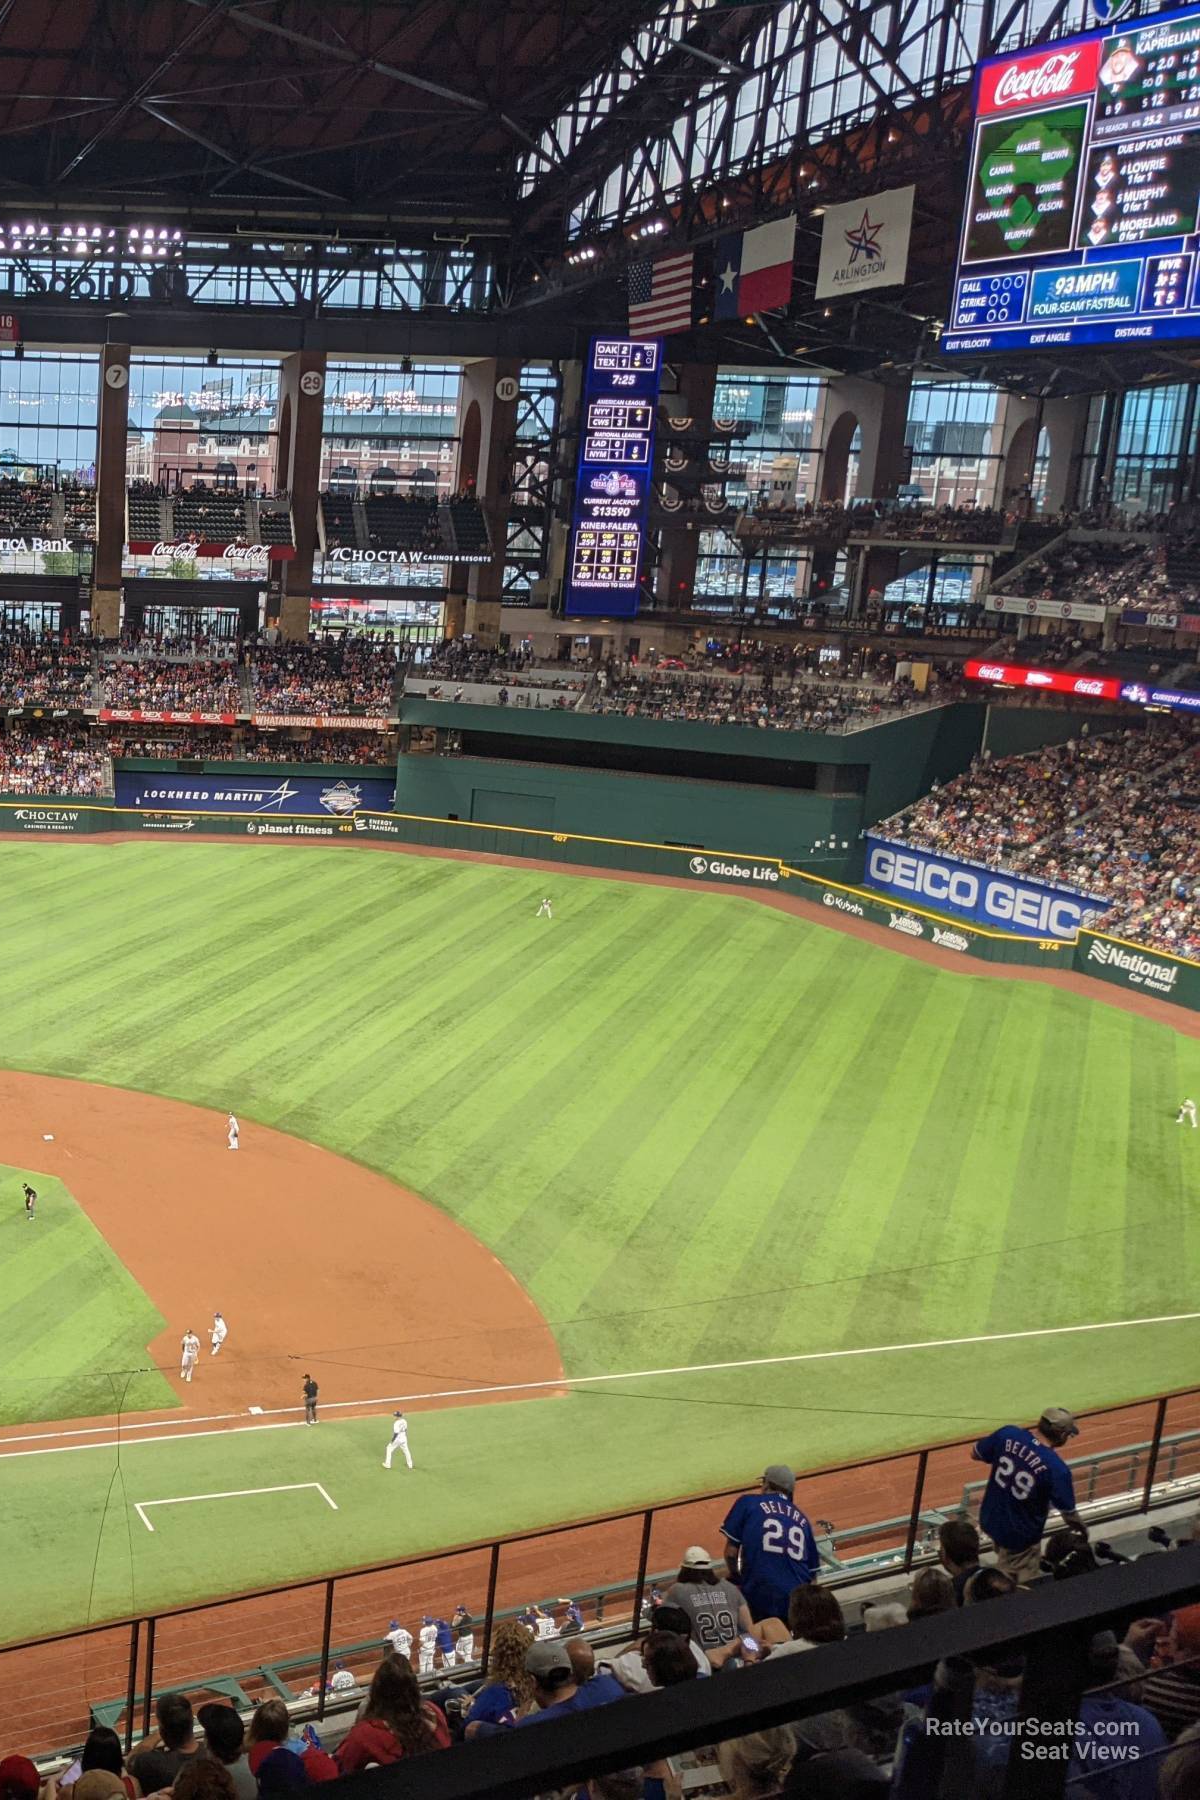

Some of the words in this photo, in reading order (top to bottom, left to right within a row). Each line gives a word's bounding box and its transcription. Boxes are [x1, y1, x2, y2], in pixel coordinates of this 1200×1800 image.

[1157, 56, 1175, 71] 2.0
[1151, 93, 1165, 107] 12
[1117, 143, 1135, 155] DUE
[1135, 141, 1146, 152] UP
[1127, 157, 1167, 174] LOWRIE
[1123, 185, 1168, 203] MURPHY
[1037, 200, 1063, 212] OLSON
[1119, 214, 1178, 231] MORELAND
[833, 259, 886, 282] ARLINGTON
[962, 283, 981, 293] BALL
[1055, 277, 1074, 295] 93
[1076, 271, 1117, 293] MPH
[960, 296, 986, 309] STRIKE
[1033, 300, 1084, 315] FOUR-SEAM
[1085, 296, 1131, 311] FASTBALL
[958, 313, 976, 324] OUT
[1114, 326, 1152, 338] DISTANCE
[598, 345, 617, 354] OAK
[598, 358, 615, 366] TEX
[112, 370, 122, 382] 7
[611, 374, 636, 385] 7:25
[303, 376, 320, 390] 29
[500, 382, 513, 396] 10
[592, 506, 630, 517] $13590
[581, 522, 638, 531] KINER-FALEFA
[31, 537, 73, 552] Bank
[338, 547, 423, 563] CHOCTAW
[1144, 612, 1177, 628] 105.3
[924, 627, 997, 639] PLUCKERS
[1152, 692, 1180, 704] CURRENT
[111, 710, 133, 718] DEX
[141, 711, 162, 719] DEX
[171, 712, 192, 720] DEX
[200, 713, 222, 721] DEX
[255, 715, 317, 727] WHATABURGER
[322, 716, 384, 729] WHATABURGER
[143, 790, 209, 802] LOCKHEED
[213, 791, 263, 802] MARTIN
[20, 809, 78, 821] CHOCTAW
[369, 818, 393, 826] ENERGY
[258, 824, 295, 835] planet
[296, 824, 334, 835] fitness
[710, 861, 751, 879] Globe
[753, 866, 779, 882] Life
[869, 848, 980, 908] GEICO
[985, 881, 1103, 940] GEIC
[835, 897, 865, 917] Kubota
[1039, 940, 1059, 952] 374
[1108, 947, 1178, 986] National
[1129, 972, 1142, 983] Car
[1143, 976, 1172, 993] Rental
[1005, 1438, 1048, 1475] BELTRE
[994, 1456, 1035, 1500] 29
[759, 1501, 807, 1528] BELTRE
[762, 1518, 806, 1561] 29
[696, 1610, 736, 1643] 29
